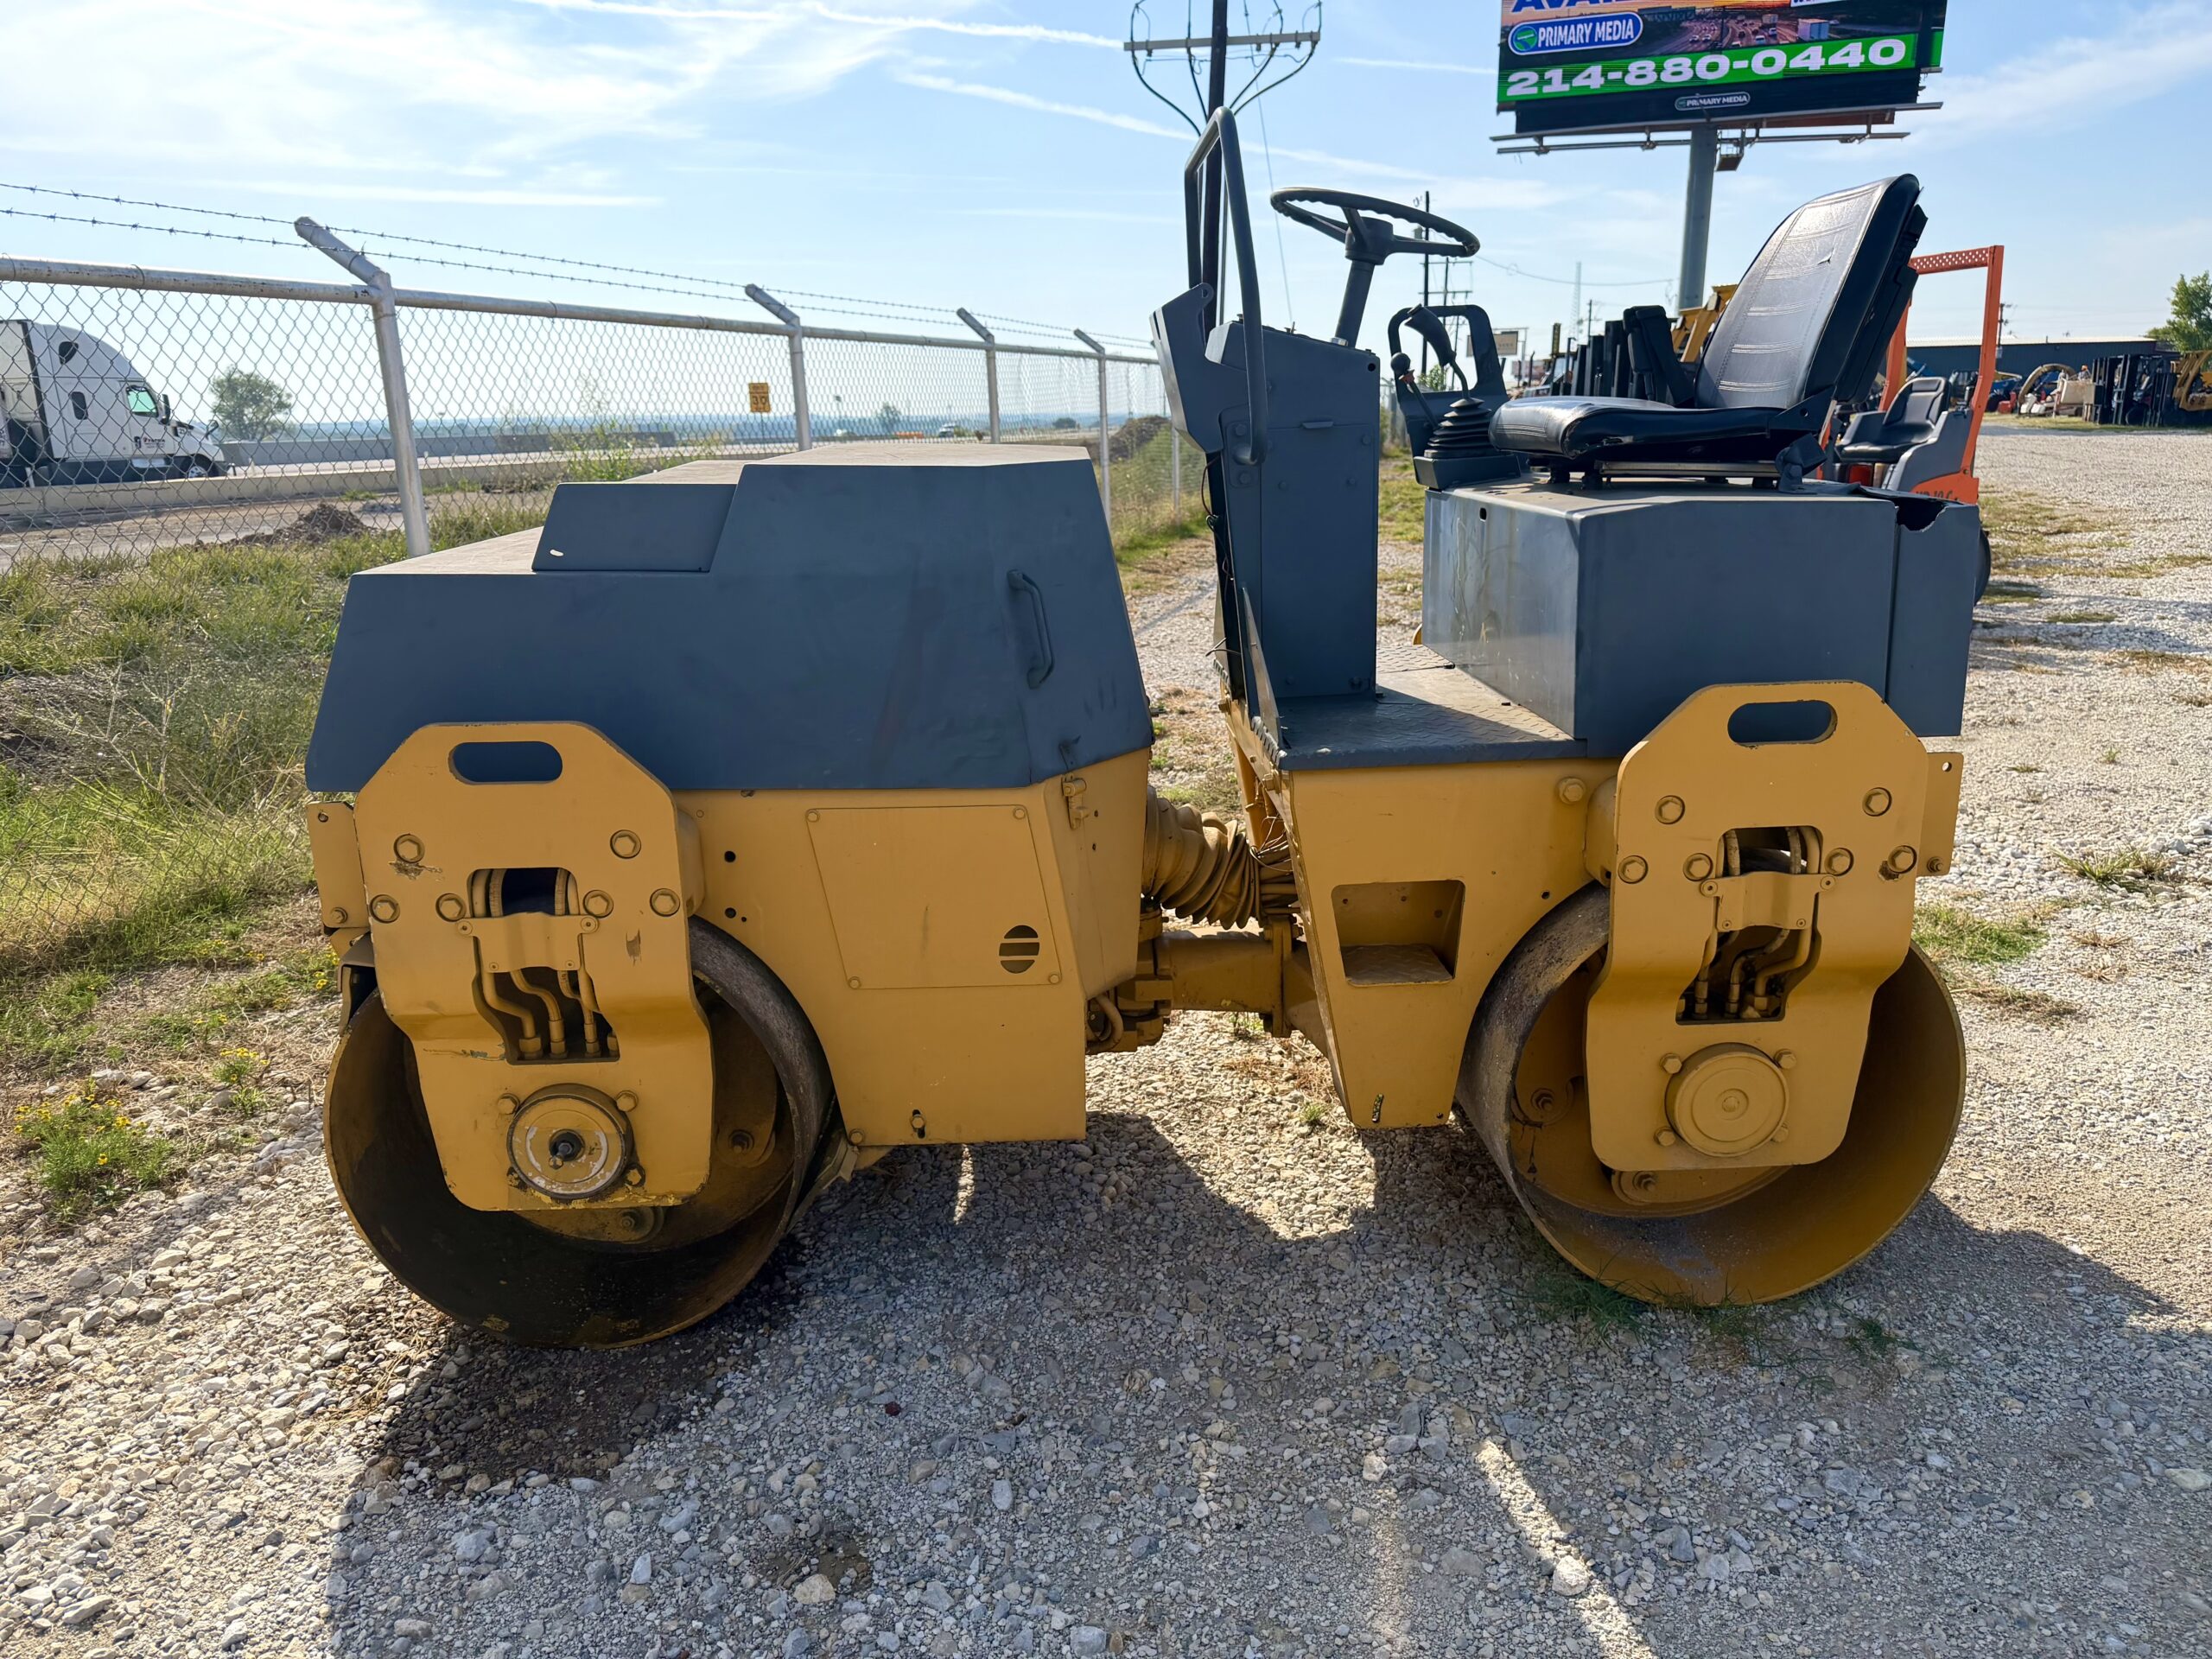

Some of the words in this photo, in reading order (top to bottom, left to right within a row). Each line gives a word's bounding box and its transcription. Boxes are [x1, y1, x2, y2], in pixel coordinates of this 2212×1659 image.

[1538, 22, 1592, 48] PRIMARY
[1595, 19, 1634, 42] MEDIA
[1507, 39, 1906, 96] 214-880-0440
[1721, 95, 1748, 104] MEDIA
